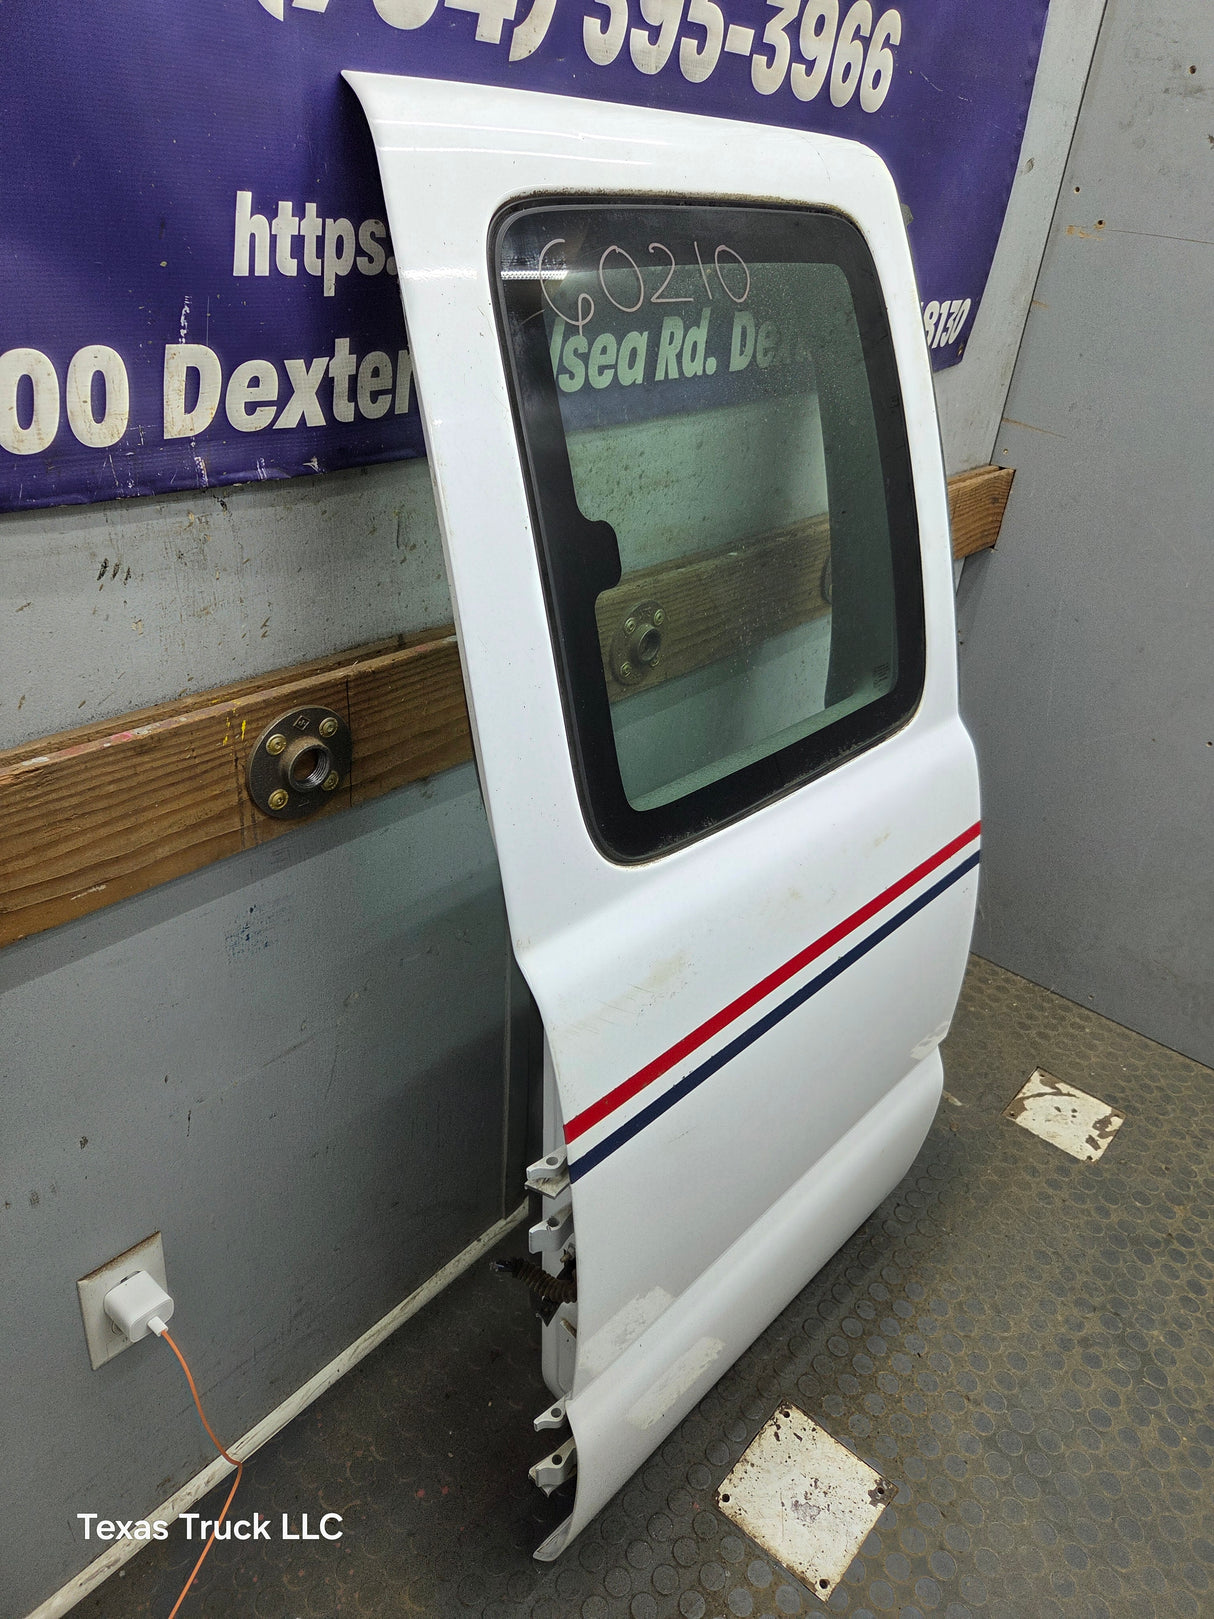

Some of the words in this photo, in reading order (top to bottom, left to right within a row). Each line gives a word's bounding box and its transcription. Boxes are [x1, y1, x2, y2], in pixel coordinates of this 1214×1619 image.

[163, 337, 414, 440] Dexter
[655, 307, 717, 382] Rd.
[920, 298, 971, 348] 8130
